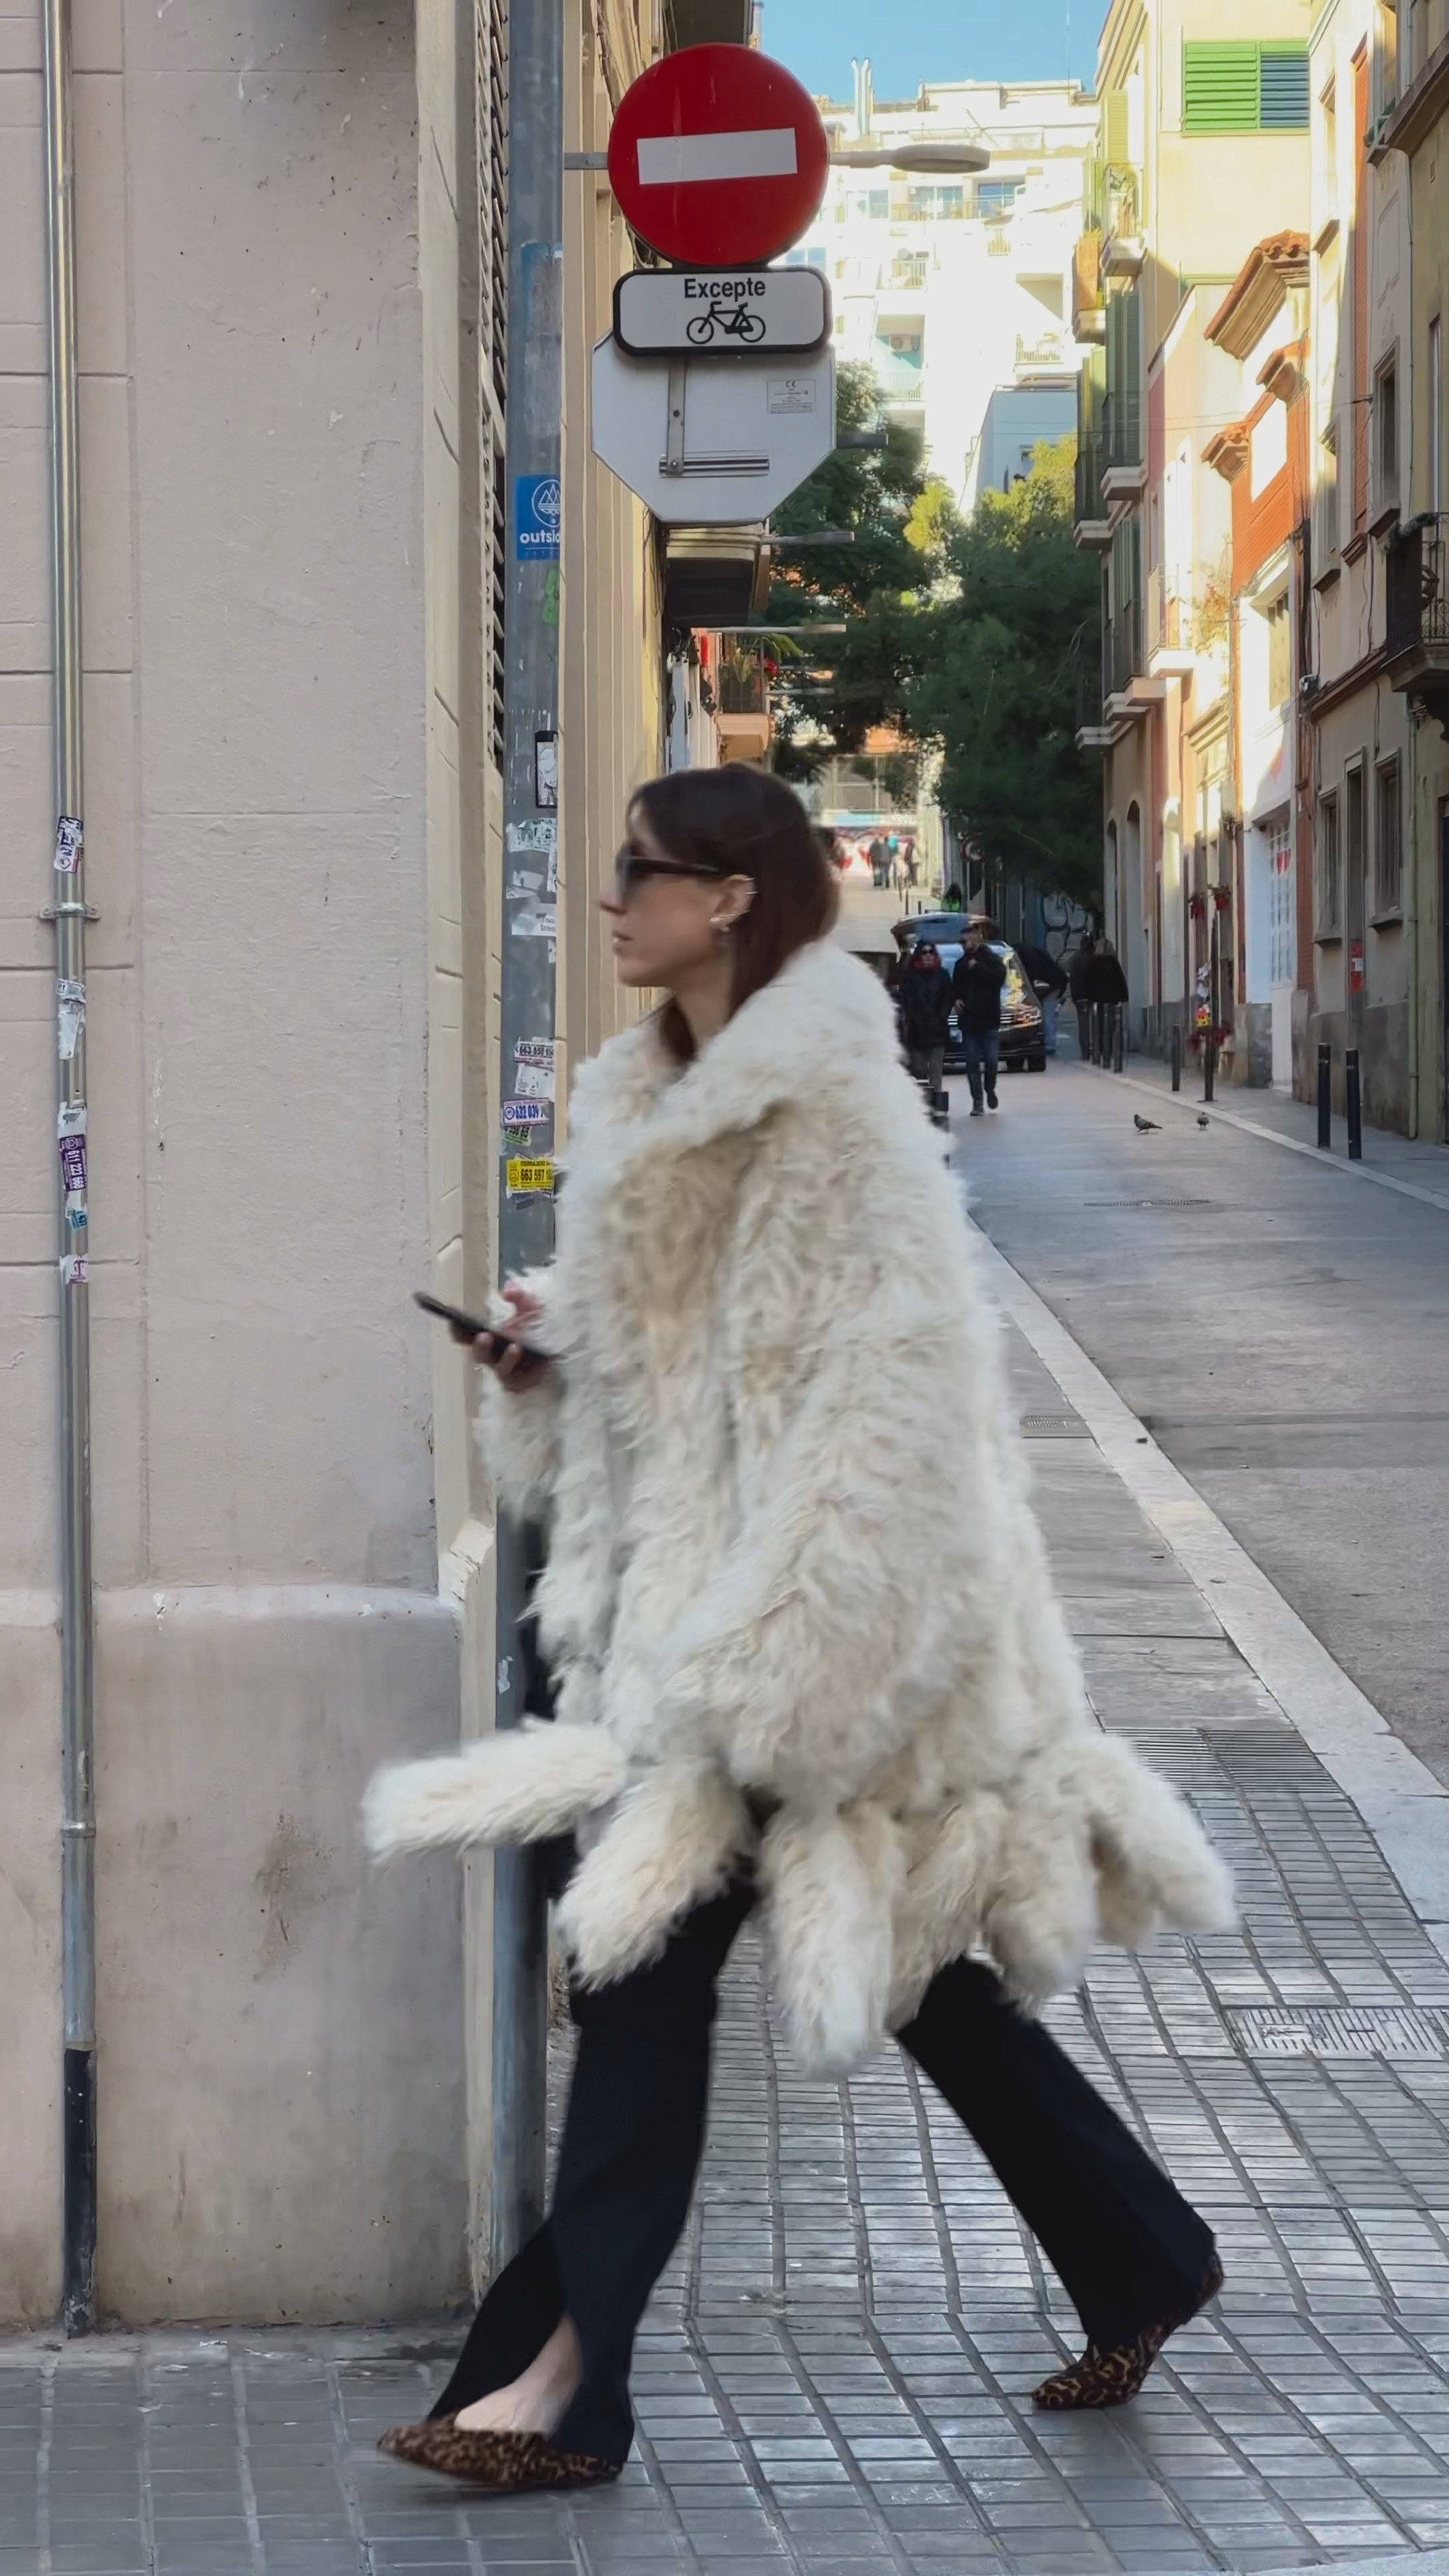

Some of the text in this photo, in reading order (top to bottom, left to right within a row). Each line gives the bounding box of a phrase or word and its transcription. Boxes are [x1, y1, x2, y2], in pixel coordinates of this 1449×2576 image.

[684, 277, 765, 302] Excepte
[68, 1150, 80, 1163] 611
[70, 1163, 83, 1176] 223
[521, 1169, 532, 1181] 663
[534, 1169, 545, 1181] 597
